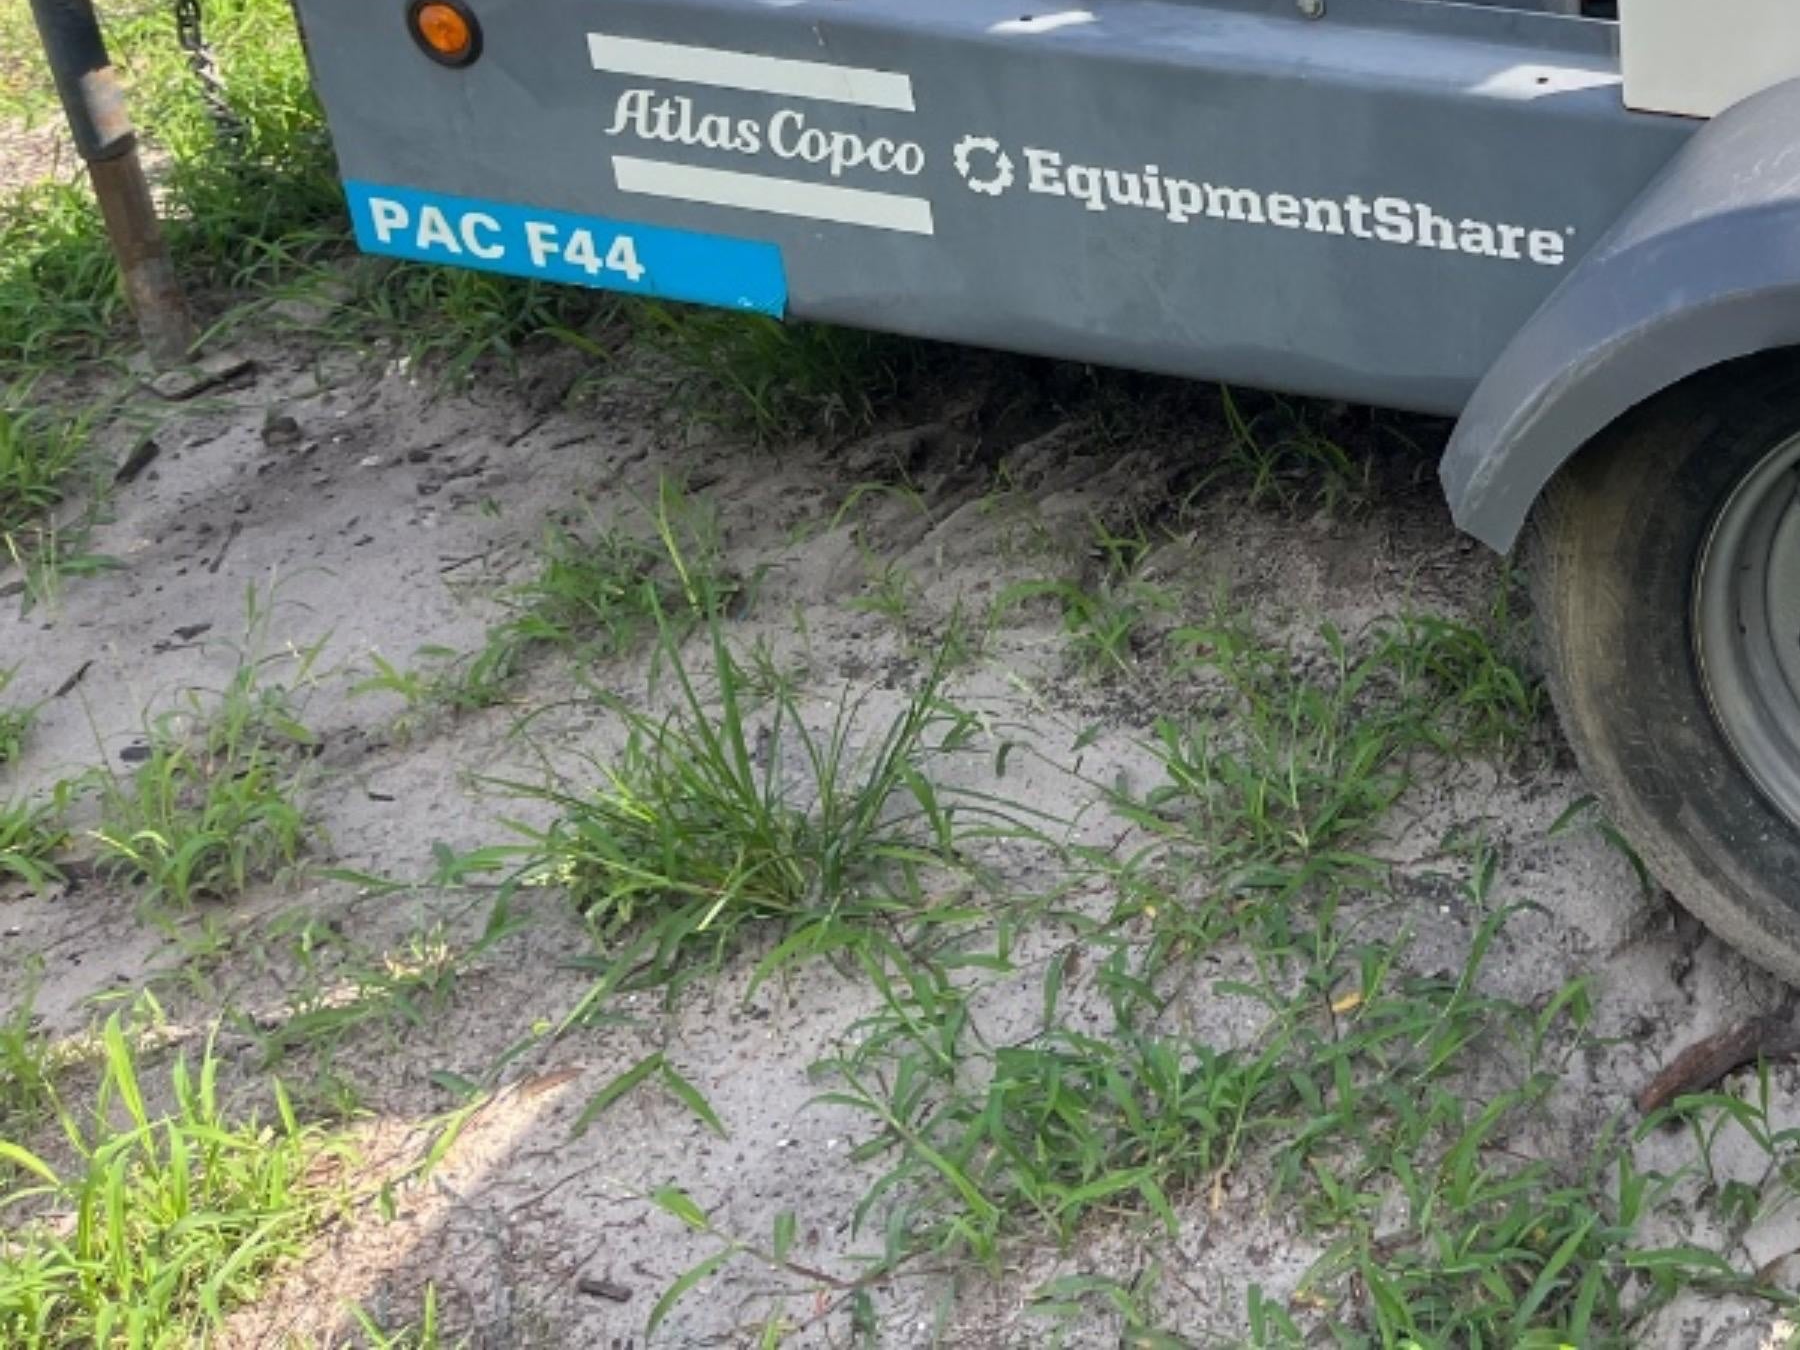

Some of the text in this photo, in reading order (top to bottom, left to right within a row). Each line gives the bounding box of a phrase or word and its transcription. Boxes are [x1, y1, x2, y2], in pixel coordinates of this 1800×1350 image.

[604, 88, 925, 176] Atlas Copco
[368, 197, 646, 281] PAC F44
[1022, 147, 1566, 265] EquipmentShare
